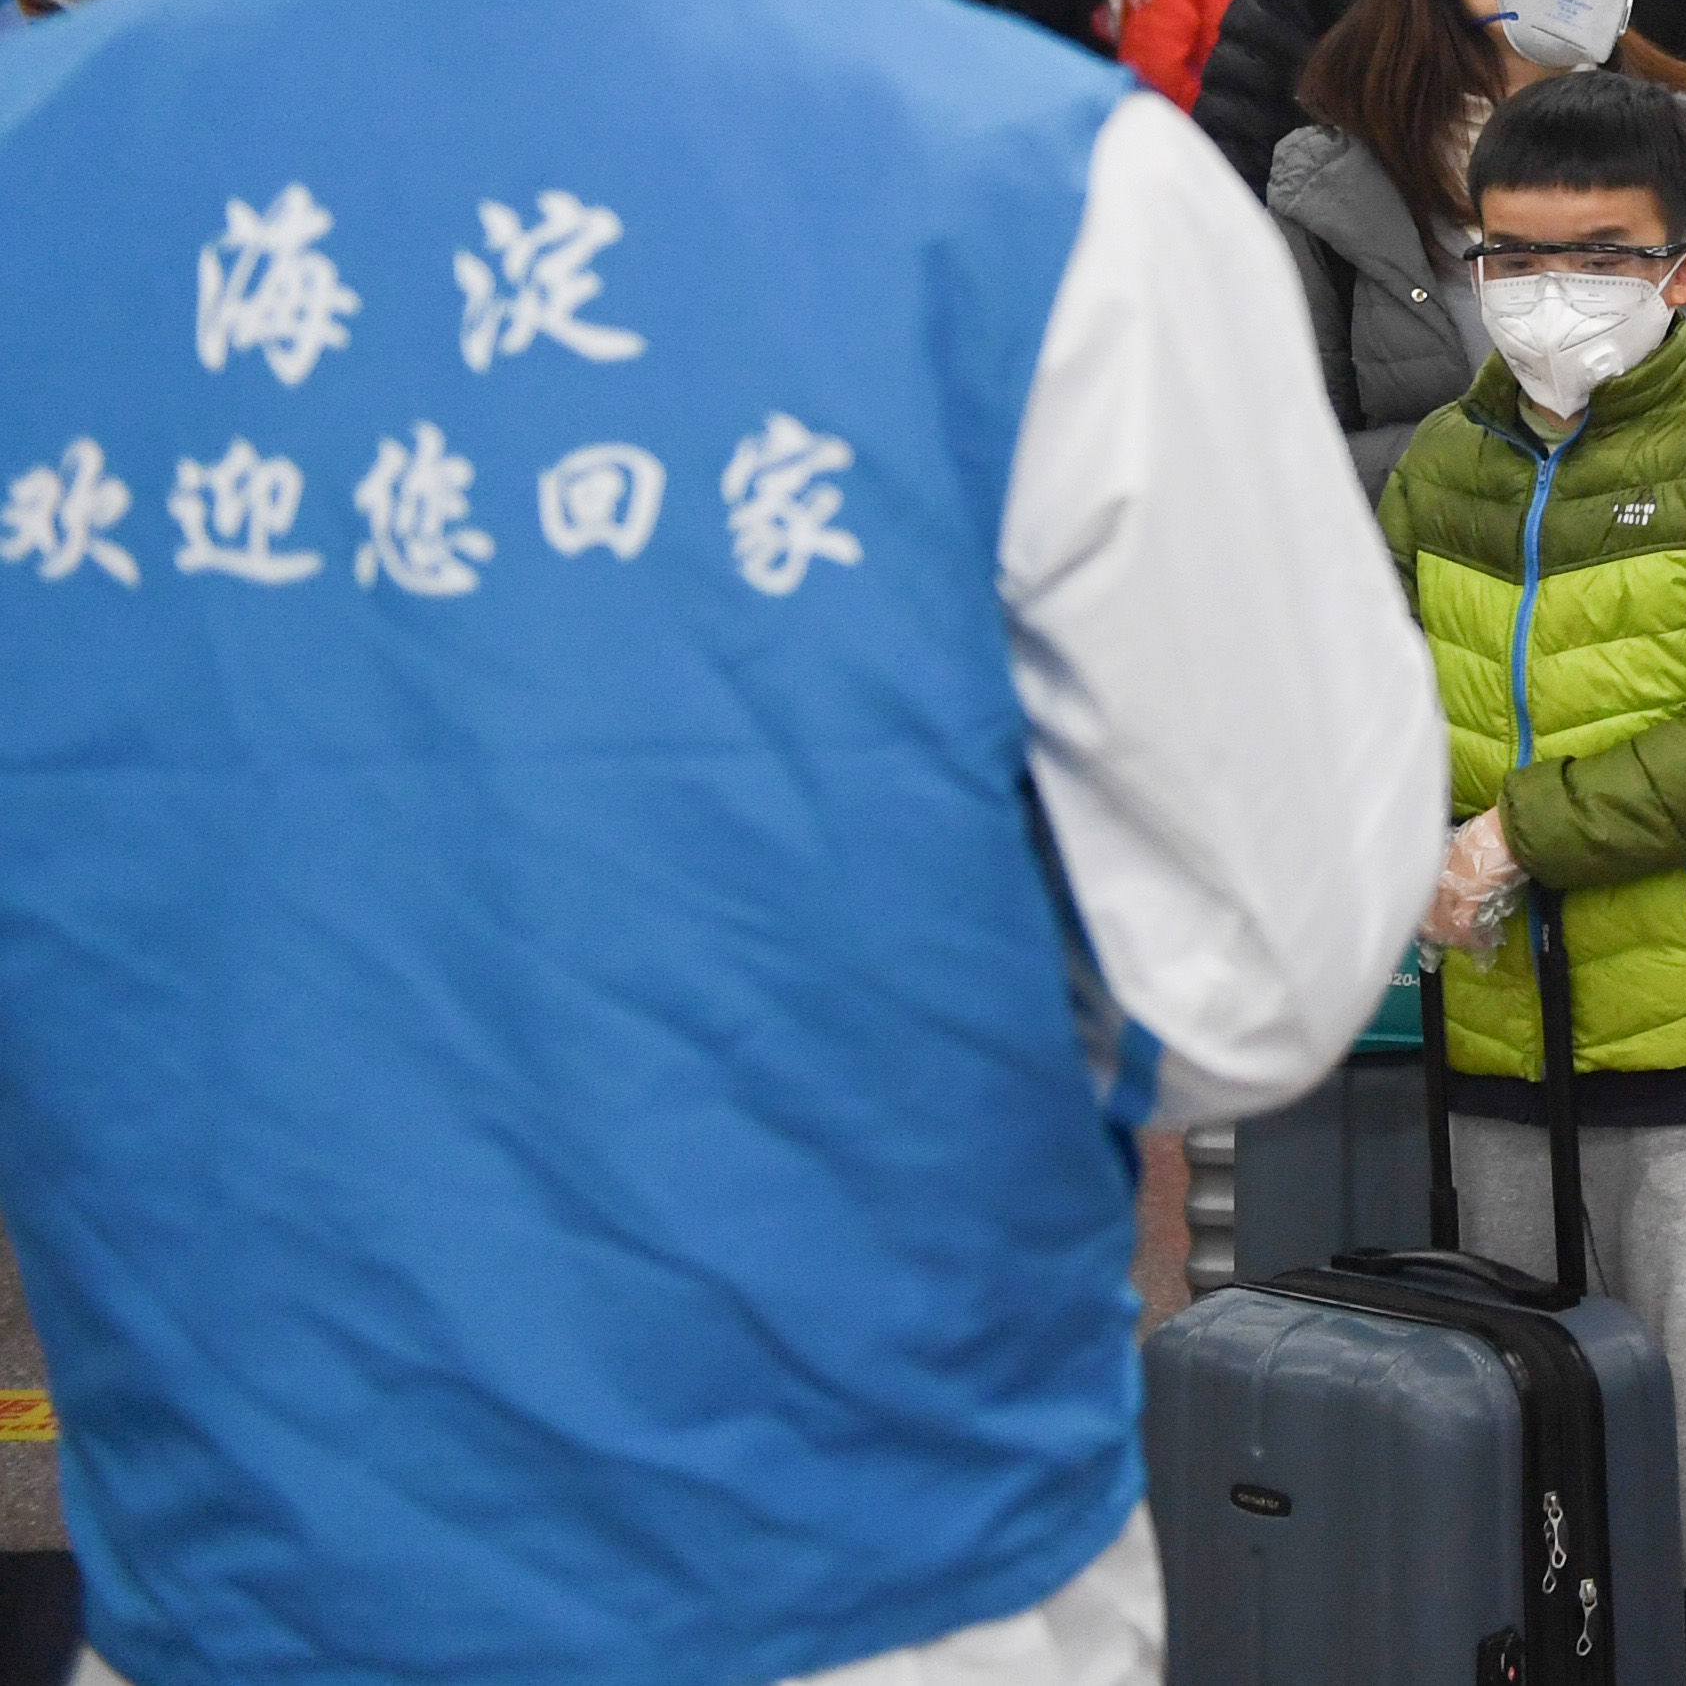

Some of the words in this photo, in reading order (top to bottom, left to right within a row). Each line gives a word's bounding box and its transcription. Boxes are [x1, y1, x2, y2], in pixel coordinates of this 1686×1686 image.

[195, 183, 647, 386] 海淀
[0, 412, 864, 597] 欢迎您回家
